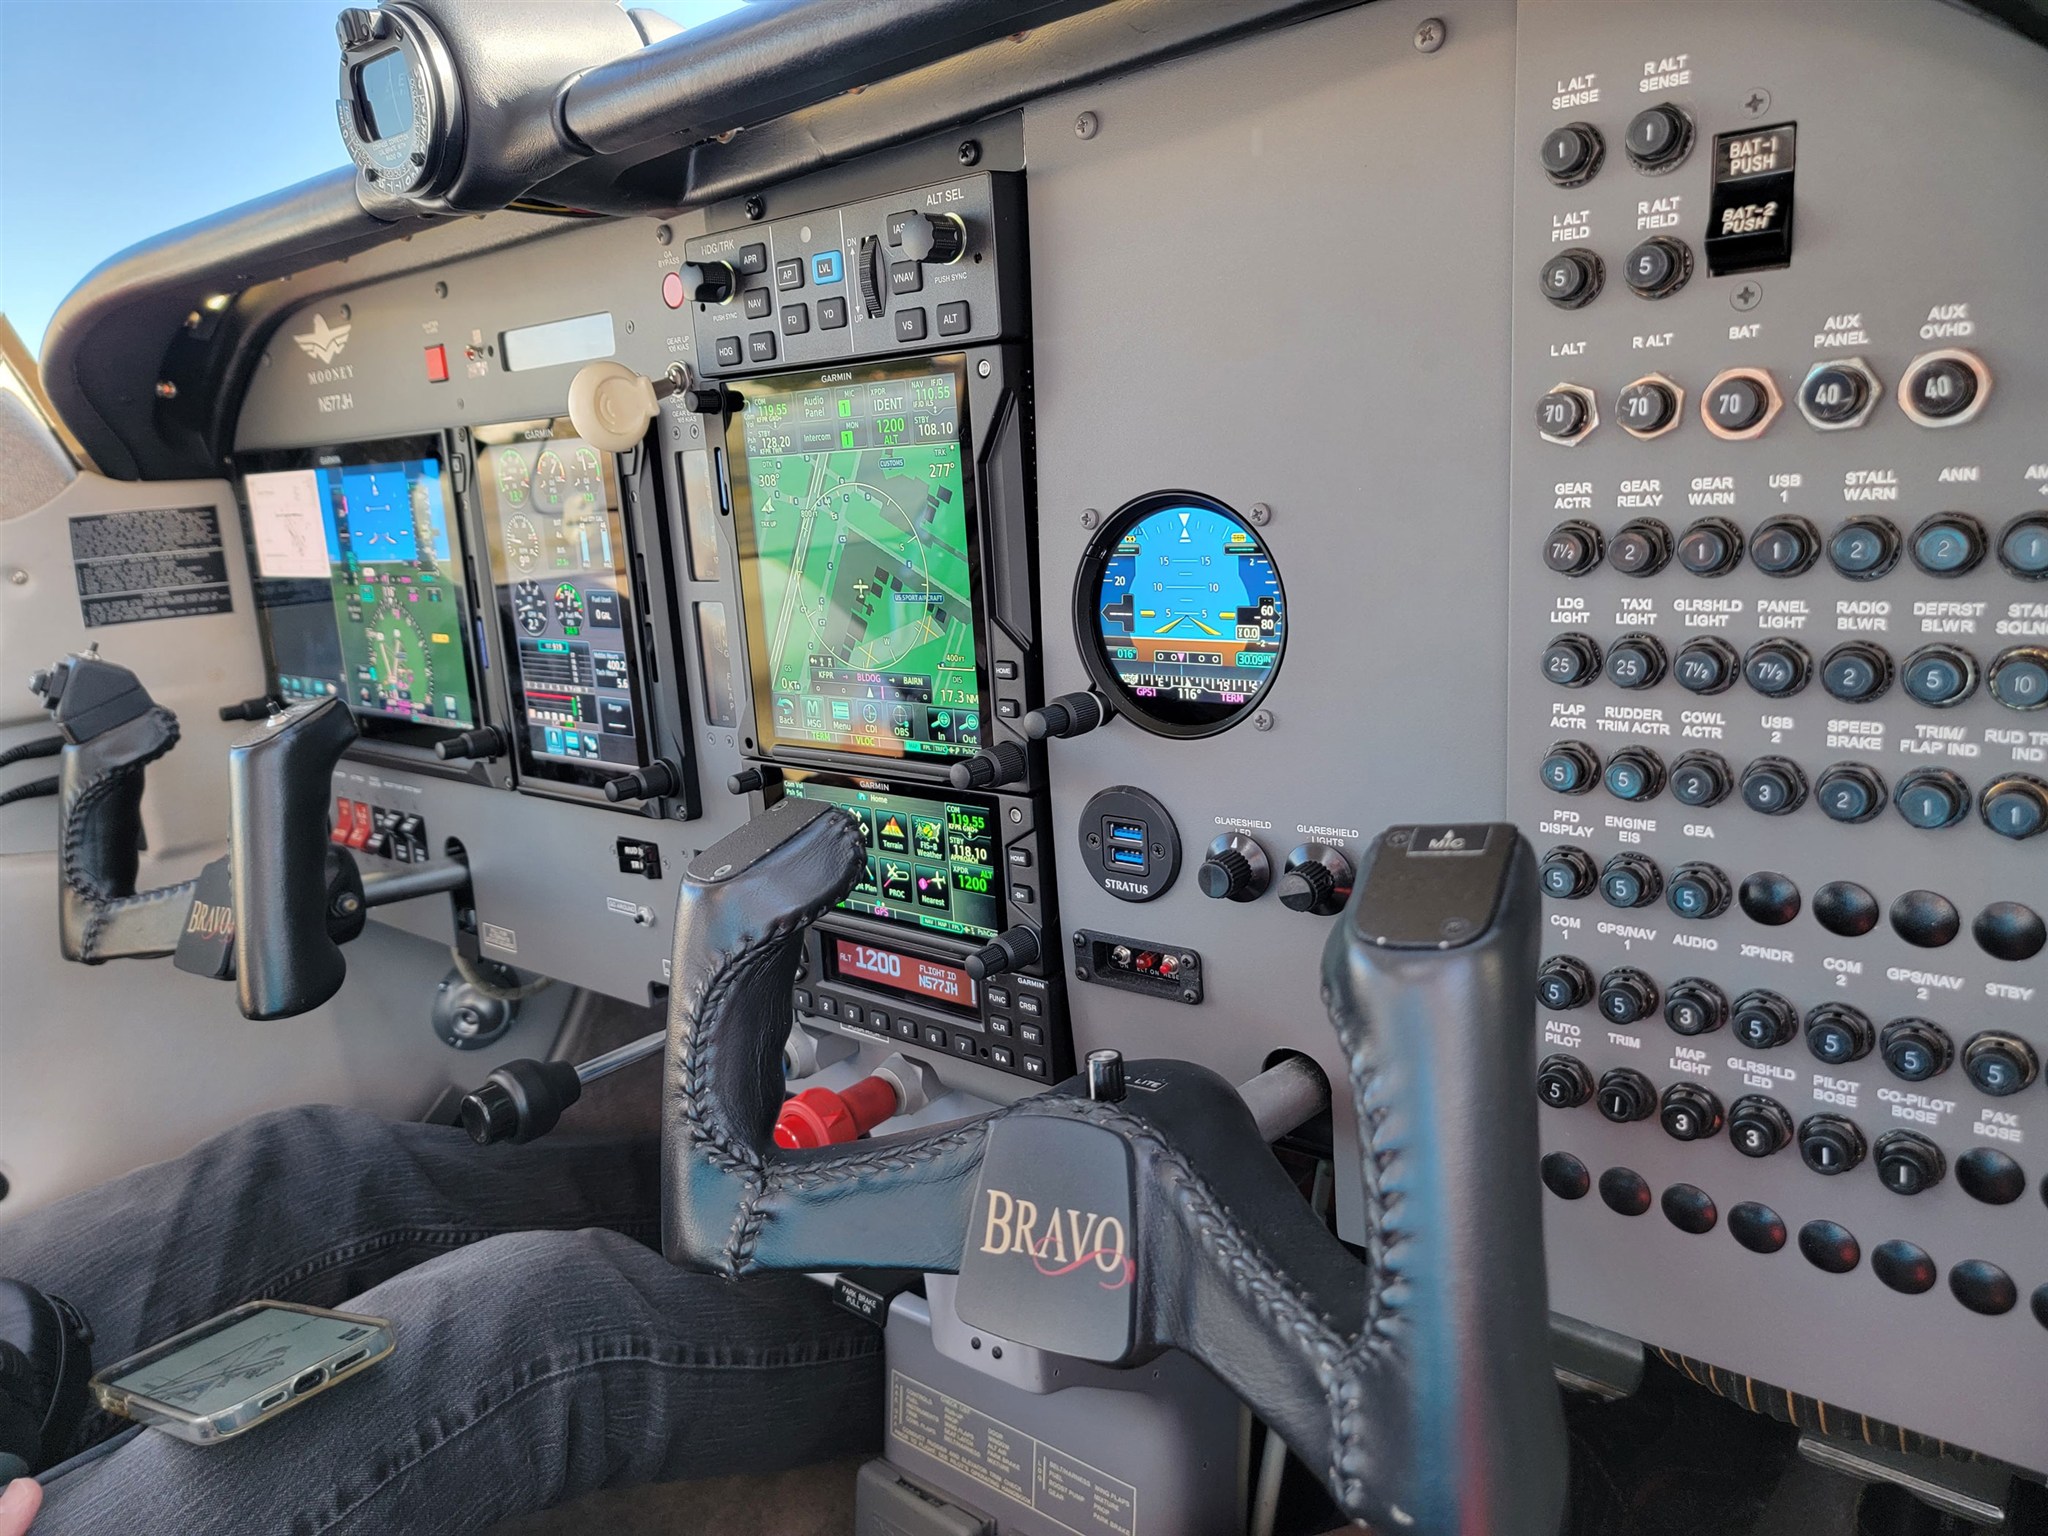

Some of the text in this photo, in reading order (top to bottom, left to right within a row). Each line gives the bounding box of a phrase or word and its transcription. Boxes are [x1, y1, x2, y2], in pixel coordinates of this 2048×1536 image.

[1644, 55, 1688, 76] R ALT
[1557, 75, 1595, 93] L ALT
[1639, 71, 1691, 92] SENSE
[1551, 89, 1599, 110] SENSE
[1730, 137, 1778, 158] BAT-1
[1730, 153, 1774, 175] PUSH
[927, 188, 964, 206] ALT SEL
[1722, 202, 1778, 221] BAT-2
[1553, 211, 1590, 228] L ALT
[1722, 215, 1769, 233] PUSH
[1551, 225, 1590, 242] FIELD
[701, 239, 735, 256] HDG/TRK
[847, 238, 857, 247] DN
[744, 254, 757, 264] APR
[783, 269, 793, 280] AP
[818, 263, 831, 273] LVL
[893, 271, 914, 283] VNAV
[748, 298, 762, 309] NAV
[824, 309, 834, 320] YD
[854, 314, 864, 324] UP
[943, 314, 958, 325] ALT
[1928, 304, 1968, 321] AUX
[788, 315, 797, 325] FD
[902, 320, 913, 331] VS
[1824, 314, 1862, 330] AUX
[1729, 324, 1760, 339] BAT
[1919, 320, 1973, 338] OVHD
[1633, 333, 1673, 348] R ALT
[1814, 328, 1868, 347] PANEL
[719, 346, 733, 358] HDG
[753, 341, 767, 352] TRK
[1550, 341, 1586, 356] L ALT
[308, 365, 353, 385] MOONEY
[821, 372, 852, 383] GARMIN
[915, 386, 950, 400] 110.55
[1924, 376, 1950, 399] 40
[803, 396, 824, 406] Audio
[1815, 384, 1839, 406] 40
[318, 393, 353, 412] N577JH
[873, 397, 903, 412] IDENT
[1628, 399, 1648, 418] 70
[1719, 394, 1740, 414] 70
[758, 404, 788, 416] 119.55
[805, 408, 825, 418] Panel
[1545, 404, 1563, 422] 70
[876, 418, 905, 433] 1200
[918, 421, 953, 436] 108.10
[761, 436, 791, 449] 128.20
[803, 433, 832, 443] Intercom
[929, 462, 955, 478] 277°
[1938, 467, 1979, 482] ANN
[1691, 477, 1733, 490] GEAR
[1769, 474, 1801, 488] USB
[1845, 471, 1897, 485] STALL
[1554, 483, 1592, 495] GEAR
[1620, 480, 1660, 492] GEAR
[1617, 494, 1663, 507] RELAY
[1688, 492, 1734, 505] WARN
[1844, 487, 1897, 501] WARN
[1554, 497, 1591, 509] ACTR
[1114, 576, 1126, 586] 20
[1557, 597, 1584, 609] LDG
[1621, 598, 1652, 610] TAXI
[1674, 599, 1742, 612] GLRSHLD
[1757, 600, 1809, 614] PANEL
[1836, 601, 1890, 616] RADIO
[1913, 602, 1986, 616] DEFRST
[1260, 605, 1274, 617] 60
[1551, 612, 1590, 624] LIGHT
[1260, 619, 1274, 630] 80
[1616, 612, 1657, 625] LIGHT
[1685, 614, 1729, 627] LIGHT
[1758, 615, 1806, 629] LIGHT
[1837, 617, 1886, 631] BLWR
[1921, 619, 1975, 633] BLWR
[818, 671, 923, 686] KFPR BLDOG BAIRN
[2014, 676, 2032, 693] 10
[941, 689, 965, 703] 17.3
[1136, 687, 1157, 697] GPS1
[1178, 687, 1202, 700] 116°
[1221, 692, 1244, 703] TERM
[1553, 703, 1586, 715] FLAP
[1605, 706, 1663, 721] RUDDER
[779, 715, 794, 726] Back
[807, 718, 822, 728] MSG
[1550, 717, 1586, 729] ACTR
[1681, 710, 1725, 725] COWL
[1761, 715, 1794, 729] USB
[894, 726, 909, 737] OBS
[1596, 719, 1670, 735] TRIM ACTR
[1682, 725, 1722, 739] ACTR
[1827, 720, 1884, 735] SPEED
[1915, 725, 1966, 739] TRIM/
[962, 734, 977, 744] Out
[1827, 735, 1882, 750] BRAKE
[1985, 729, 2024, 743] RUD
[1900, 739, 1979, 757] FLAP IND
[2011, 747, 2044, 761] IND
[859, 780, 890, 792] GARMIN
[870, 793, 888, 804] Home
[951, 813, 985, 830] 119.55
[1214, 816, 1272, 830] GLARESHIELD
[1553, 810, 1580, 822] PFD
[1605, 815, 1656, 831] ENGINE
[1296, 824, 1360, 839] GLARESHIELD
[1539, 822, 1594, 838] DISPLAY
[1683, 824, 1714, 839] GEA
[1429, 838, 1465, 850] MIC
[1619, 831, 1641, 844] EIS
[883, 840, 904, 850] Terrain
[917, 849, 943, 860] Weather
[953, 845, 987, 860] 118.10
[958, 875, 987, 892] 1200
[1105, 878, 1148, 895] STRATUS
[188, 900, 231, 935] BRAVO
[1551, 915, 1581, 929] COM
[1597, 922, 1657, 941] GPS/NAV
[1673, 934, 1718, 951] AUDIO
[1740, 943, 1794, 963] XPNDR
[855, 946, 900, 977] 1200
[919, 964, 957, 981] FLIGHT ID
[918, 975, 958, 996] N577JH
[1017, 977, 1045, 989] GARMIN
[989, 993, 1006, 1004] FUNC
[1985, 982, 2034, 1001] STBY
[1019, 1001, 1037, 1012] CRSR
[992, 1022, 1005, 1032] CLR
[1545, 1020, 1581, 1036] AUTO
[1023, 1030, 1036, 1040] ENT
[1545, 1033, 1581, 1049] PILOT
[1608, 1032, 1641, 1049] TRIM
[1675, 1046, 1706, 1061] MAP
[1669, 1058, 1711, 1076] LIGHT
[1727, 1058, 1796, 1081] GLRSHLD
[1135, 1078, 1161, 1088] LITE
[1743, 1074, 1773, 1089] LED
[1813, 1074, 1860, 1094] PILOT
[1813, 1088, 1858, 1108] BOSE
[1877, 1088, 1956, 1113] CO-PILOT
[1891, 1104, 1938, 1124] BOSE
[1981, 1109, 2018, 1127] PAX
[1973, 1122, 2024, 1142] BOSE
[980, 1189, 1126, 1273] BRAVO
[842, 1285, 876, 1308] PARK BRAKE
[846, 1295, 871, 1315] PULL ON
